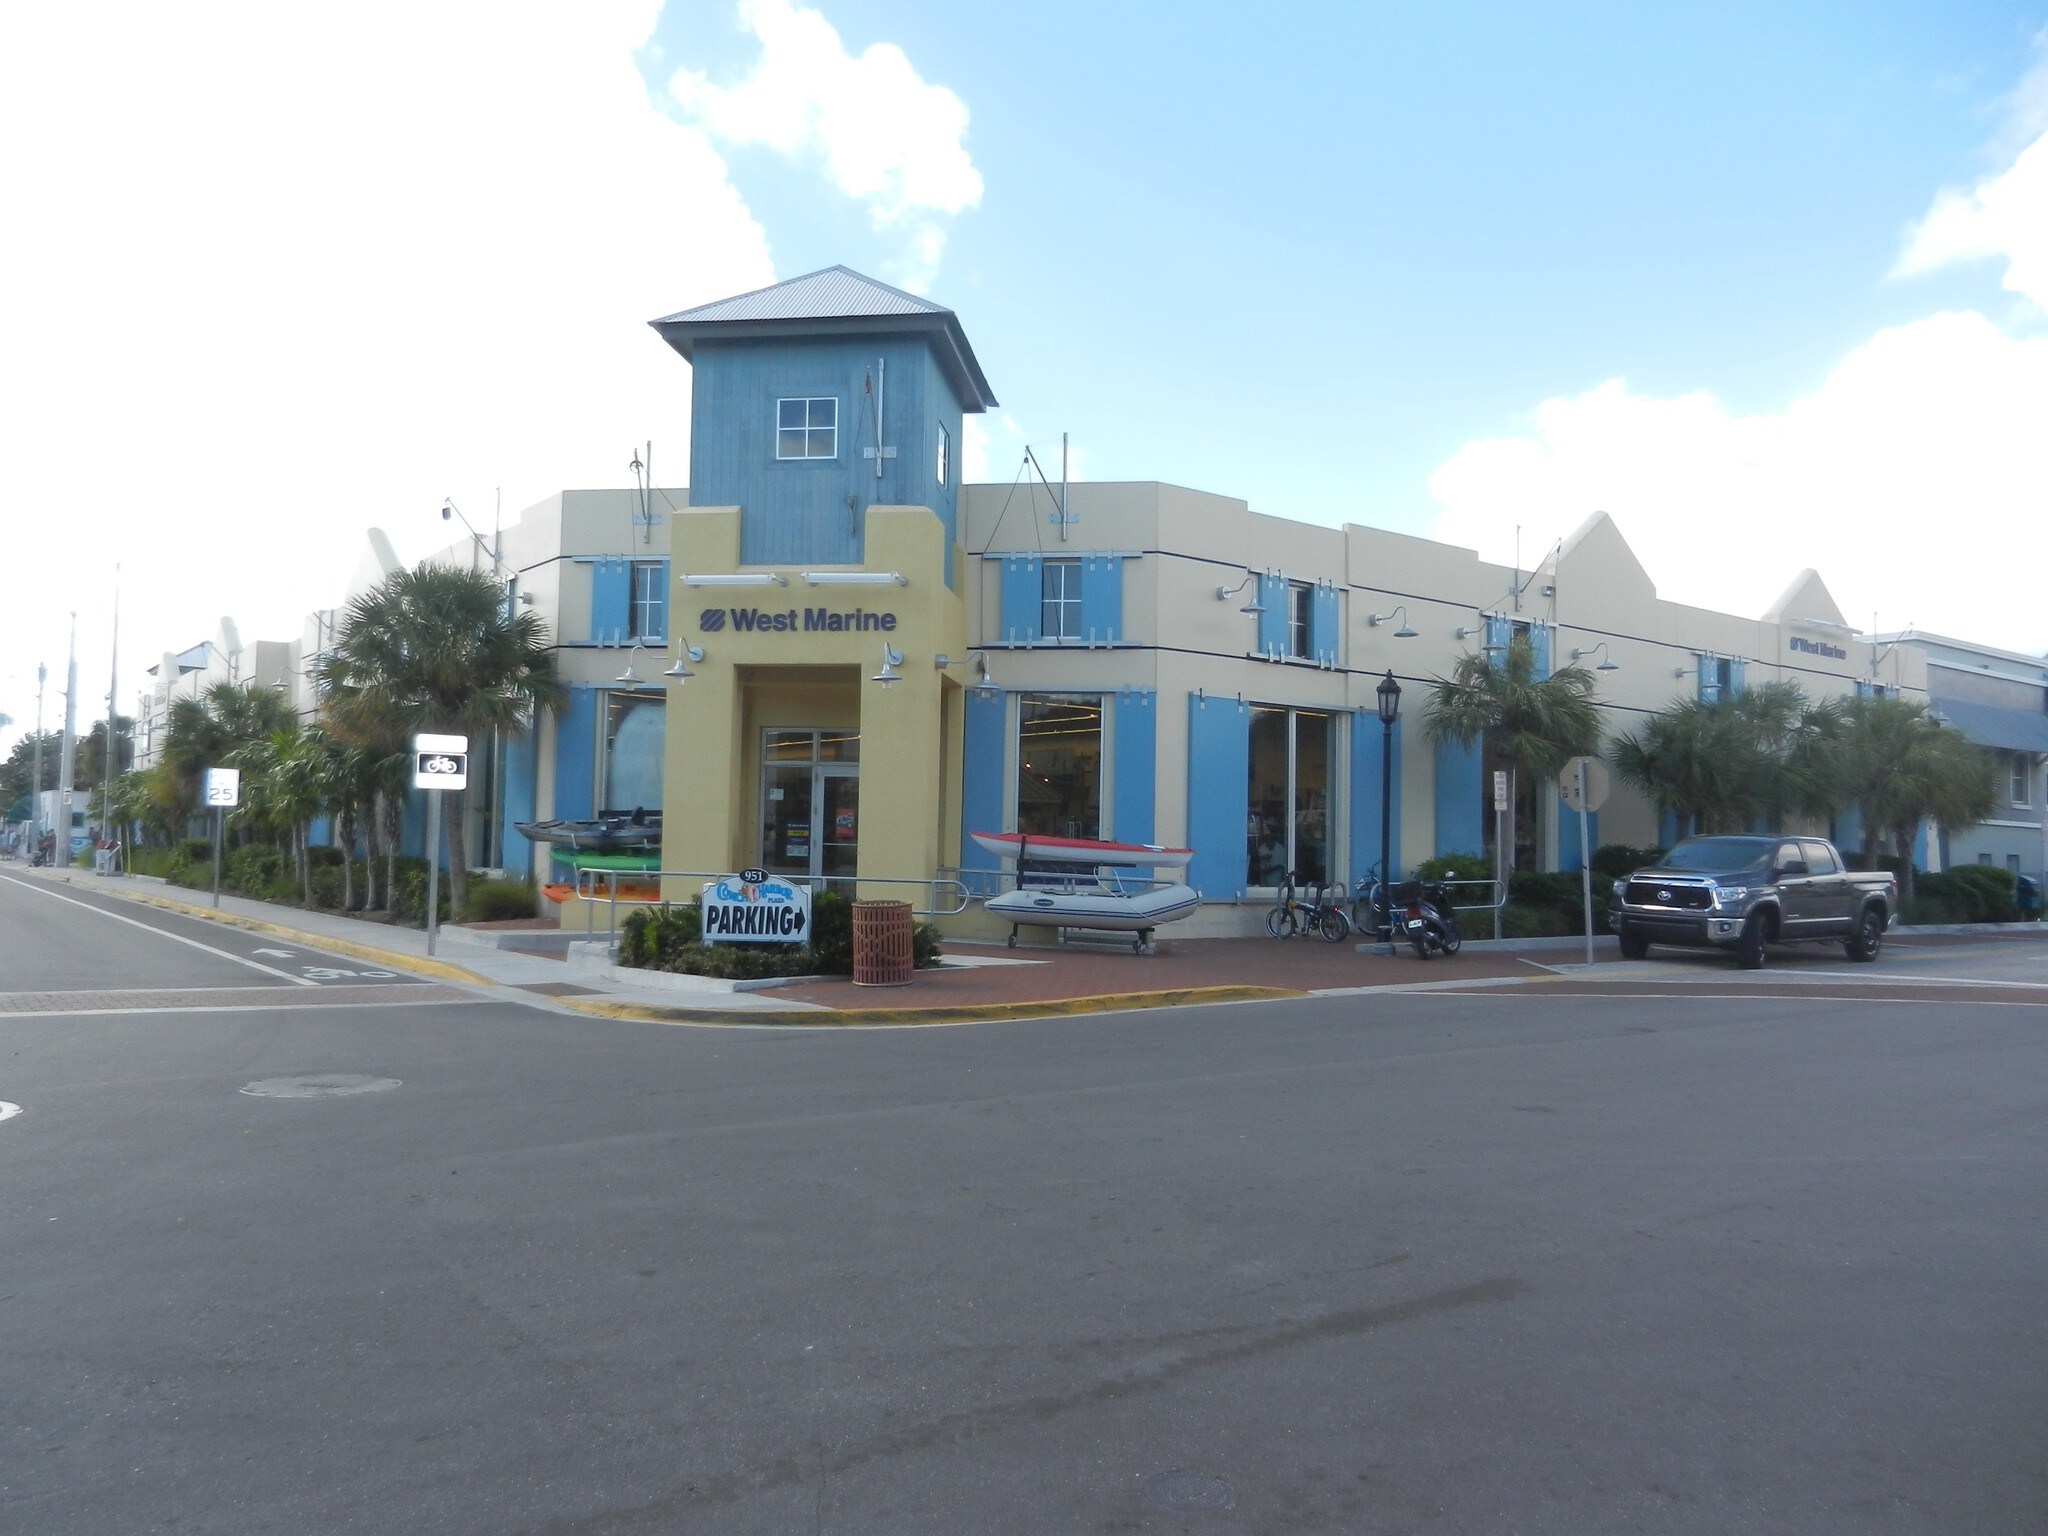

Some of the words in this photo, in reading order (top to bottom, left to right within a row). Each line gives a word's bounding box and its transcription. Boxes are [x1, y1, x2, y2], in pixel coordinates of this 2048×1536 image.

[730, 608, 798, 632] West
[804, 608, 897, 632] Marine
[1798, 637, 1819, 655] West
[1820, 642, 1847, 660] Marine
[209, 788, 233, 801] 25
[745, 870, 764, 881] 951
[706, 905, 794, 936] PARKING
